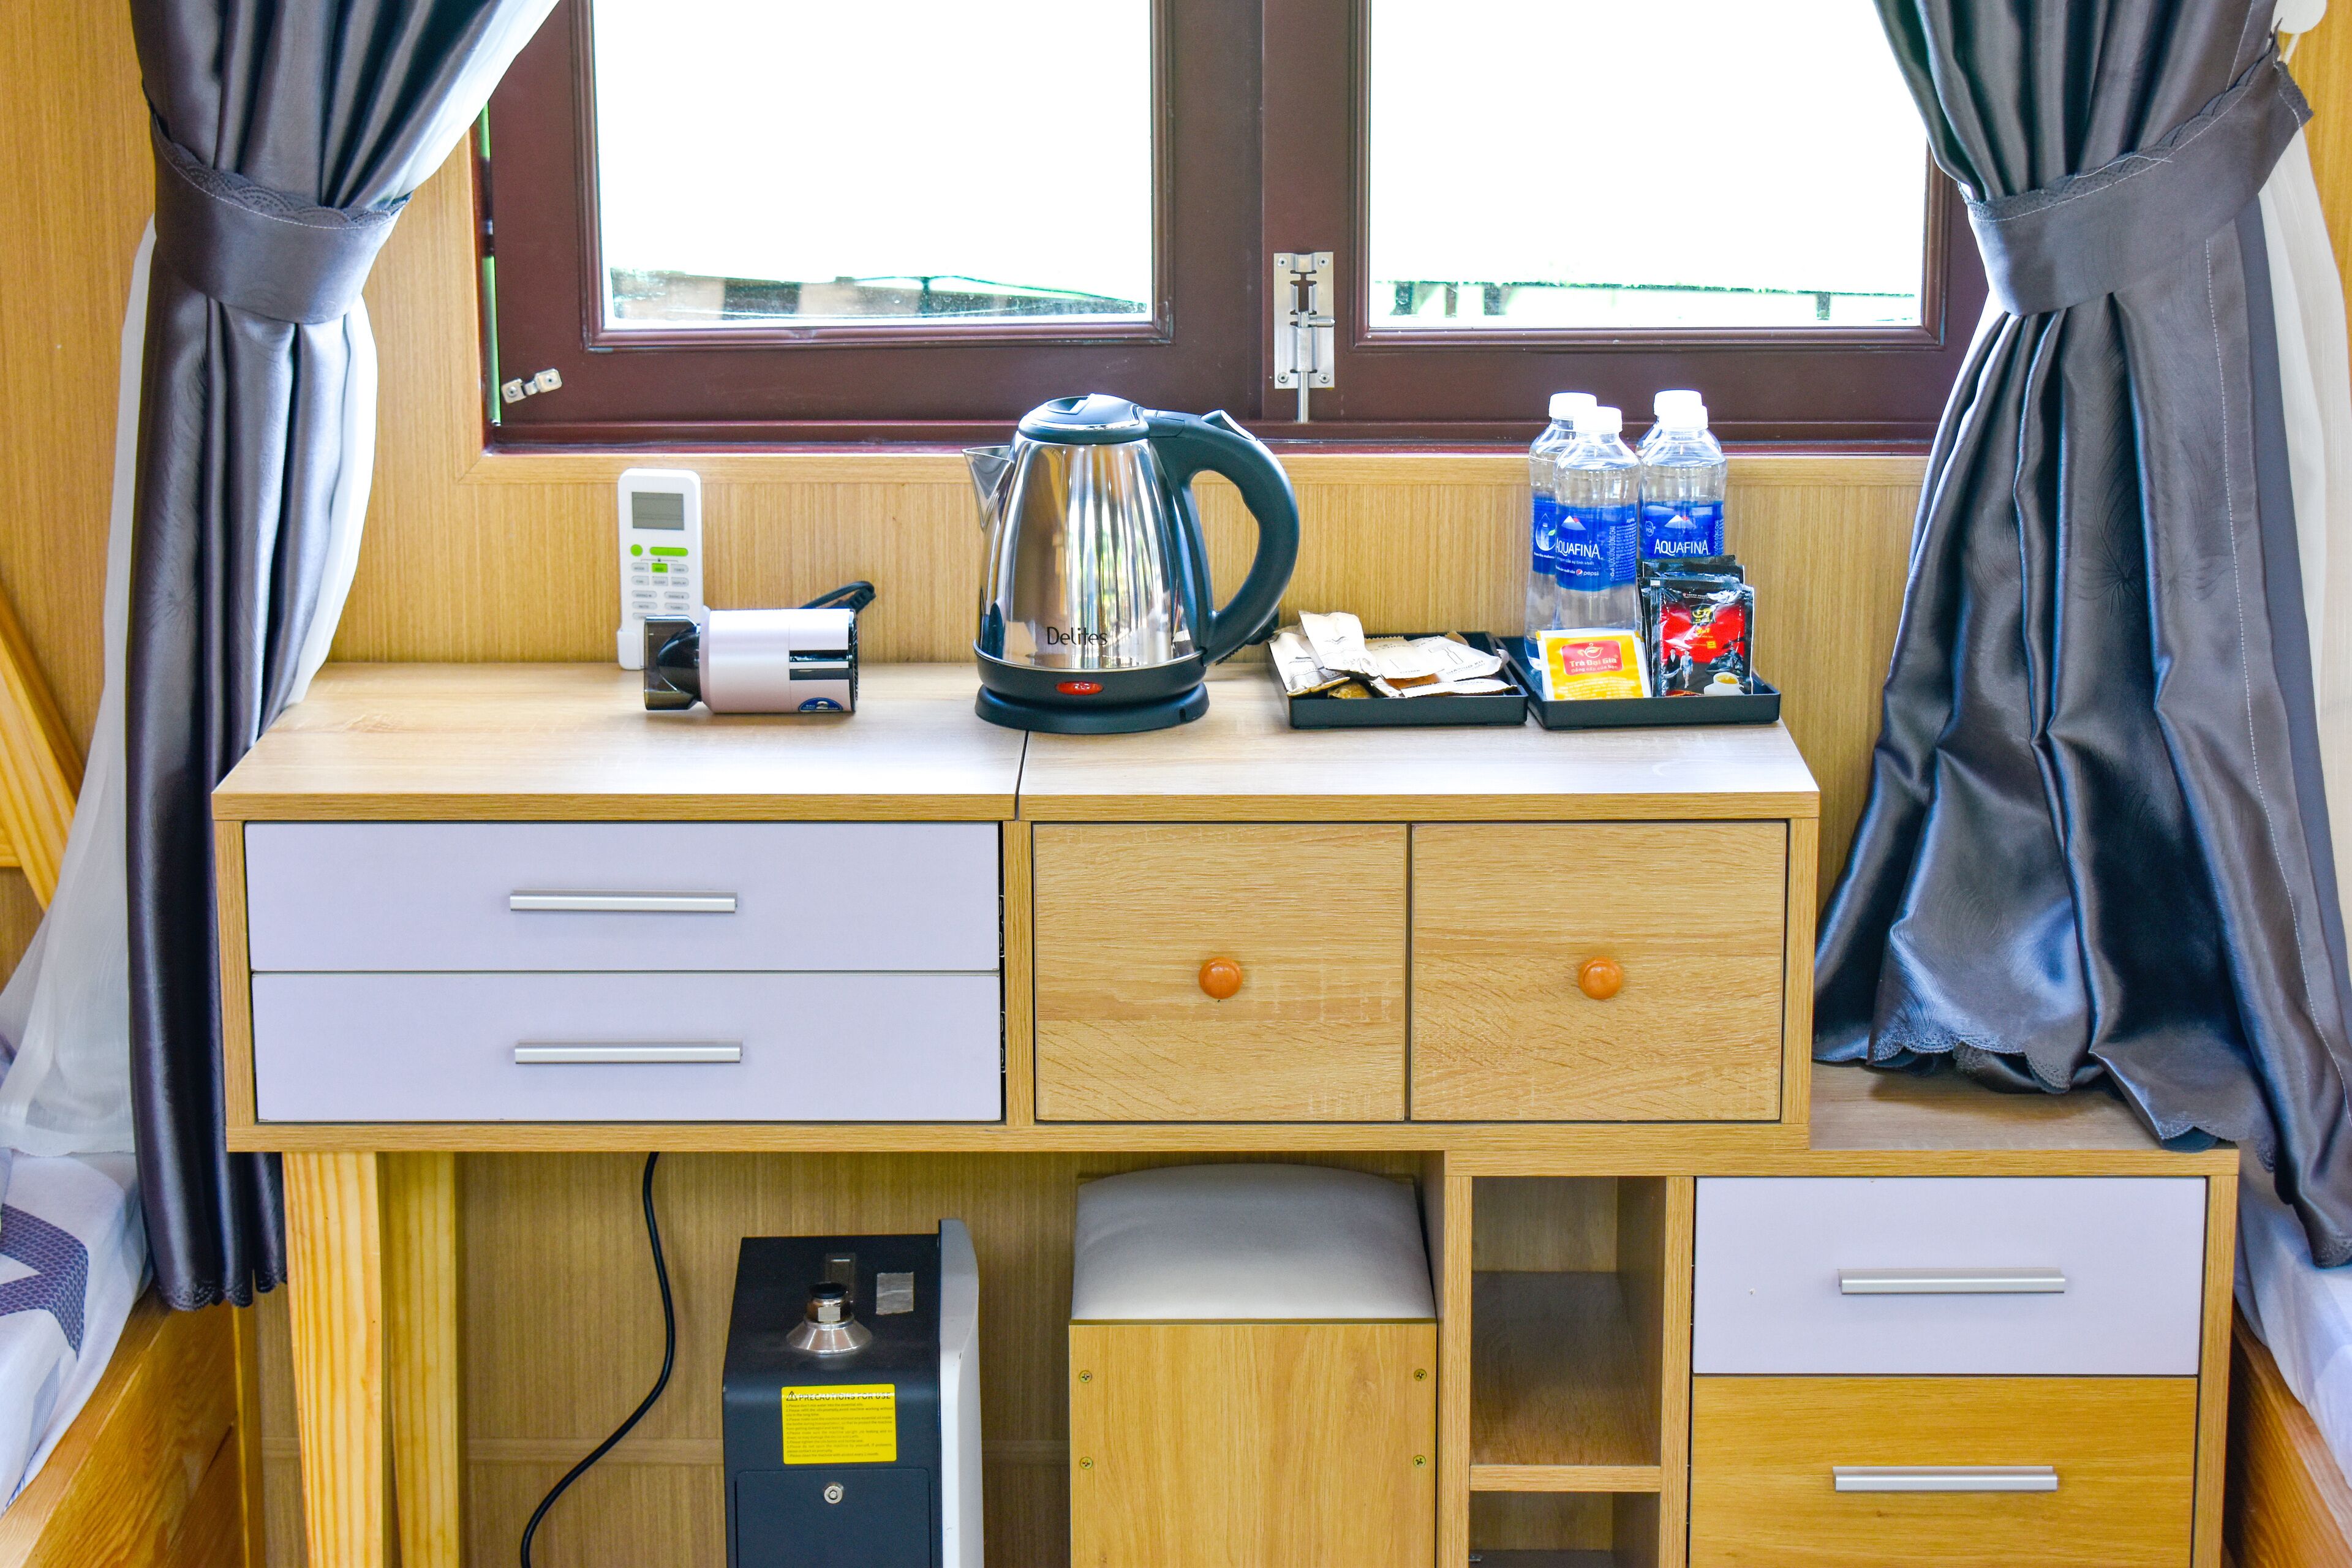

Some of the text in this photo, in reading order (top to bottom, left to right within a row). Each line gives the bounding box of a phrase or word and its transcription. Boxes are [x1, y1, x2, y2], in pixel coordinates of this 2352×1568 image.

[1556, 538, 1600, 559] AQUAFINA
[1654, 539, 1709, 556] AQUAFINA
[1047, 627, 1107, 645] Delites
